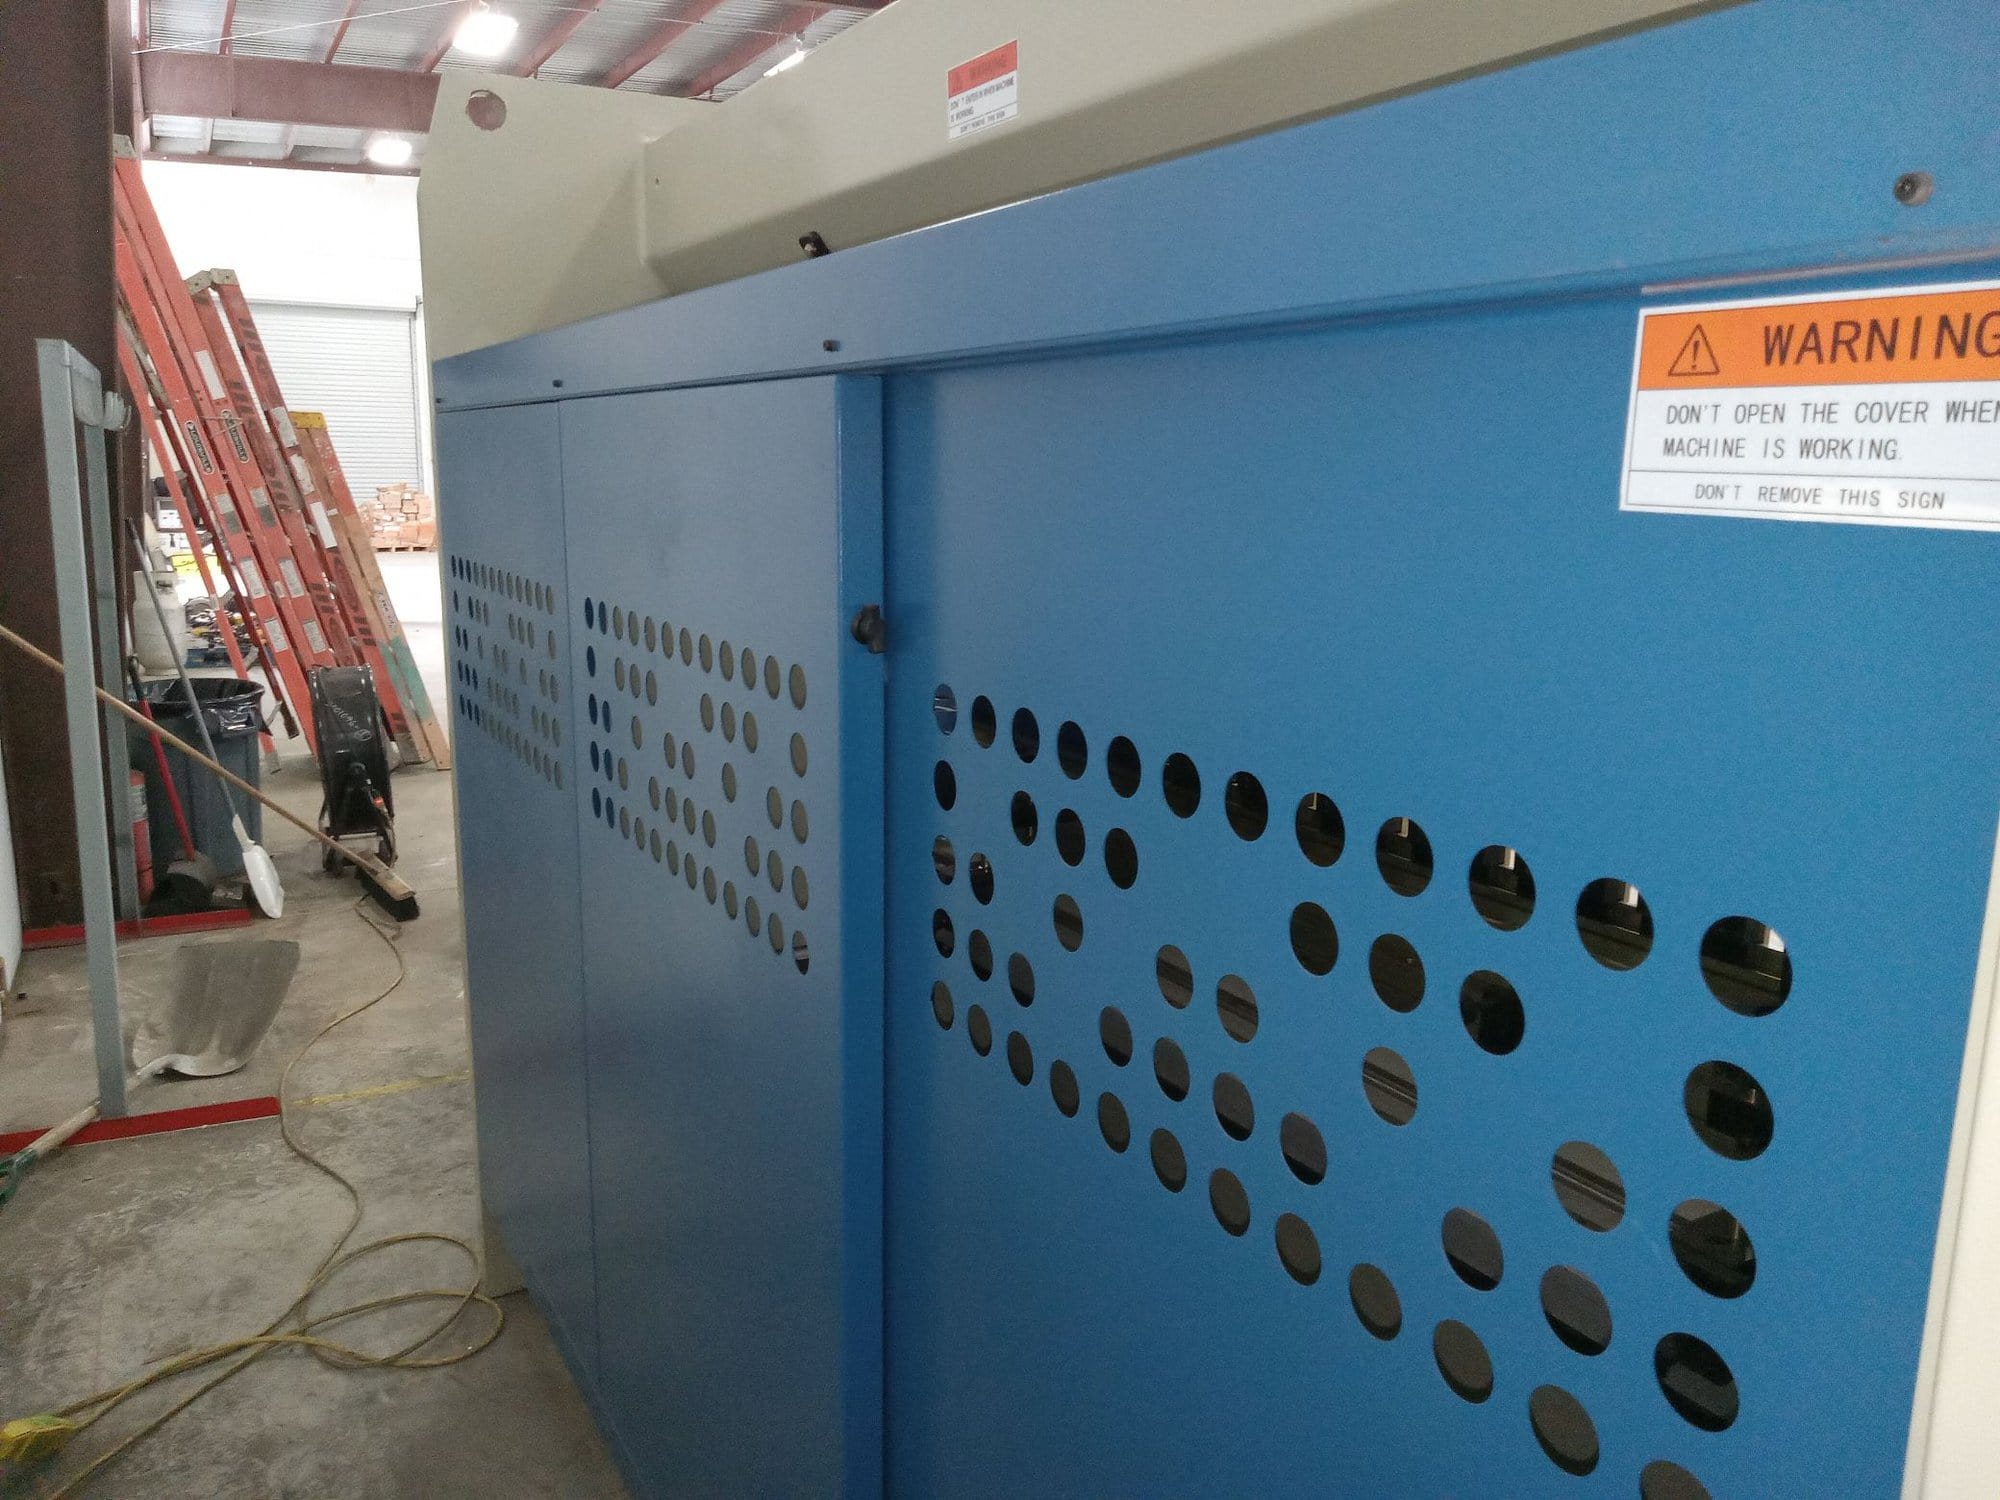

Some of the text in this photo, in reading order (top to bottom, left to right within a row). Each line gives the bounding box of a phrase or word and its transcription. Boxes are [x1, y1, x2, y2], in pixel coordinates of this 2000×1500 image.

[1763, 310, 2000, 366] WARNING
[1666, 404, 1721, 425] DON'T
[1734, 403, 1786, 424] OPEN
[1801, 402, 1840, 424] THE
[1855, 400, 1929, 424] COVER
[1663, 438, 1746, 458] MACHINE
[1763, 438, 1785, 459] IS
[1695, 484, 1945, 510] DON'T REMOVE THIS SIGN
